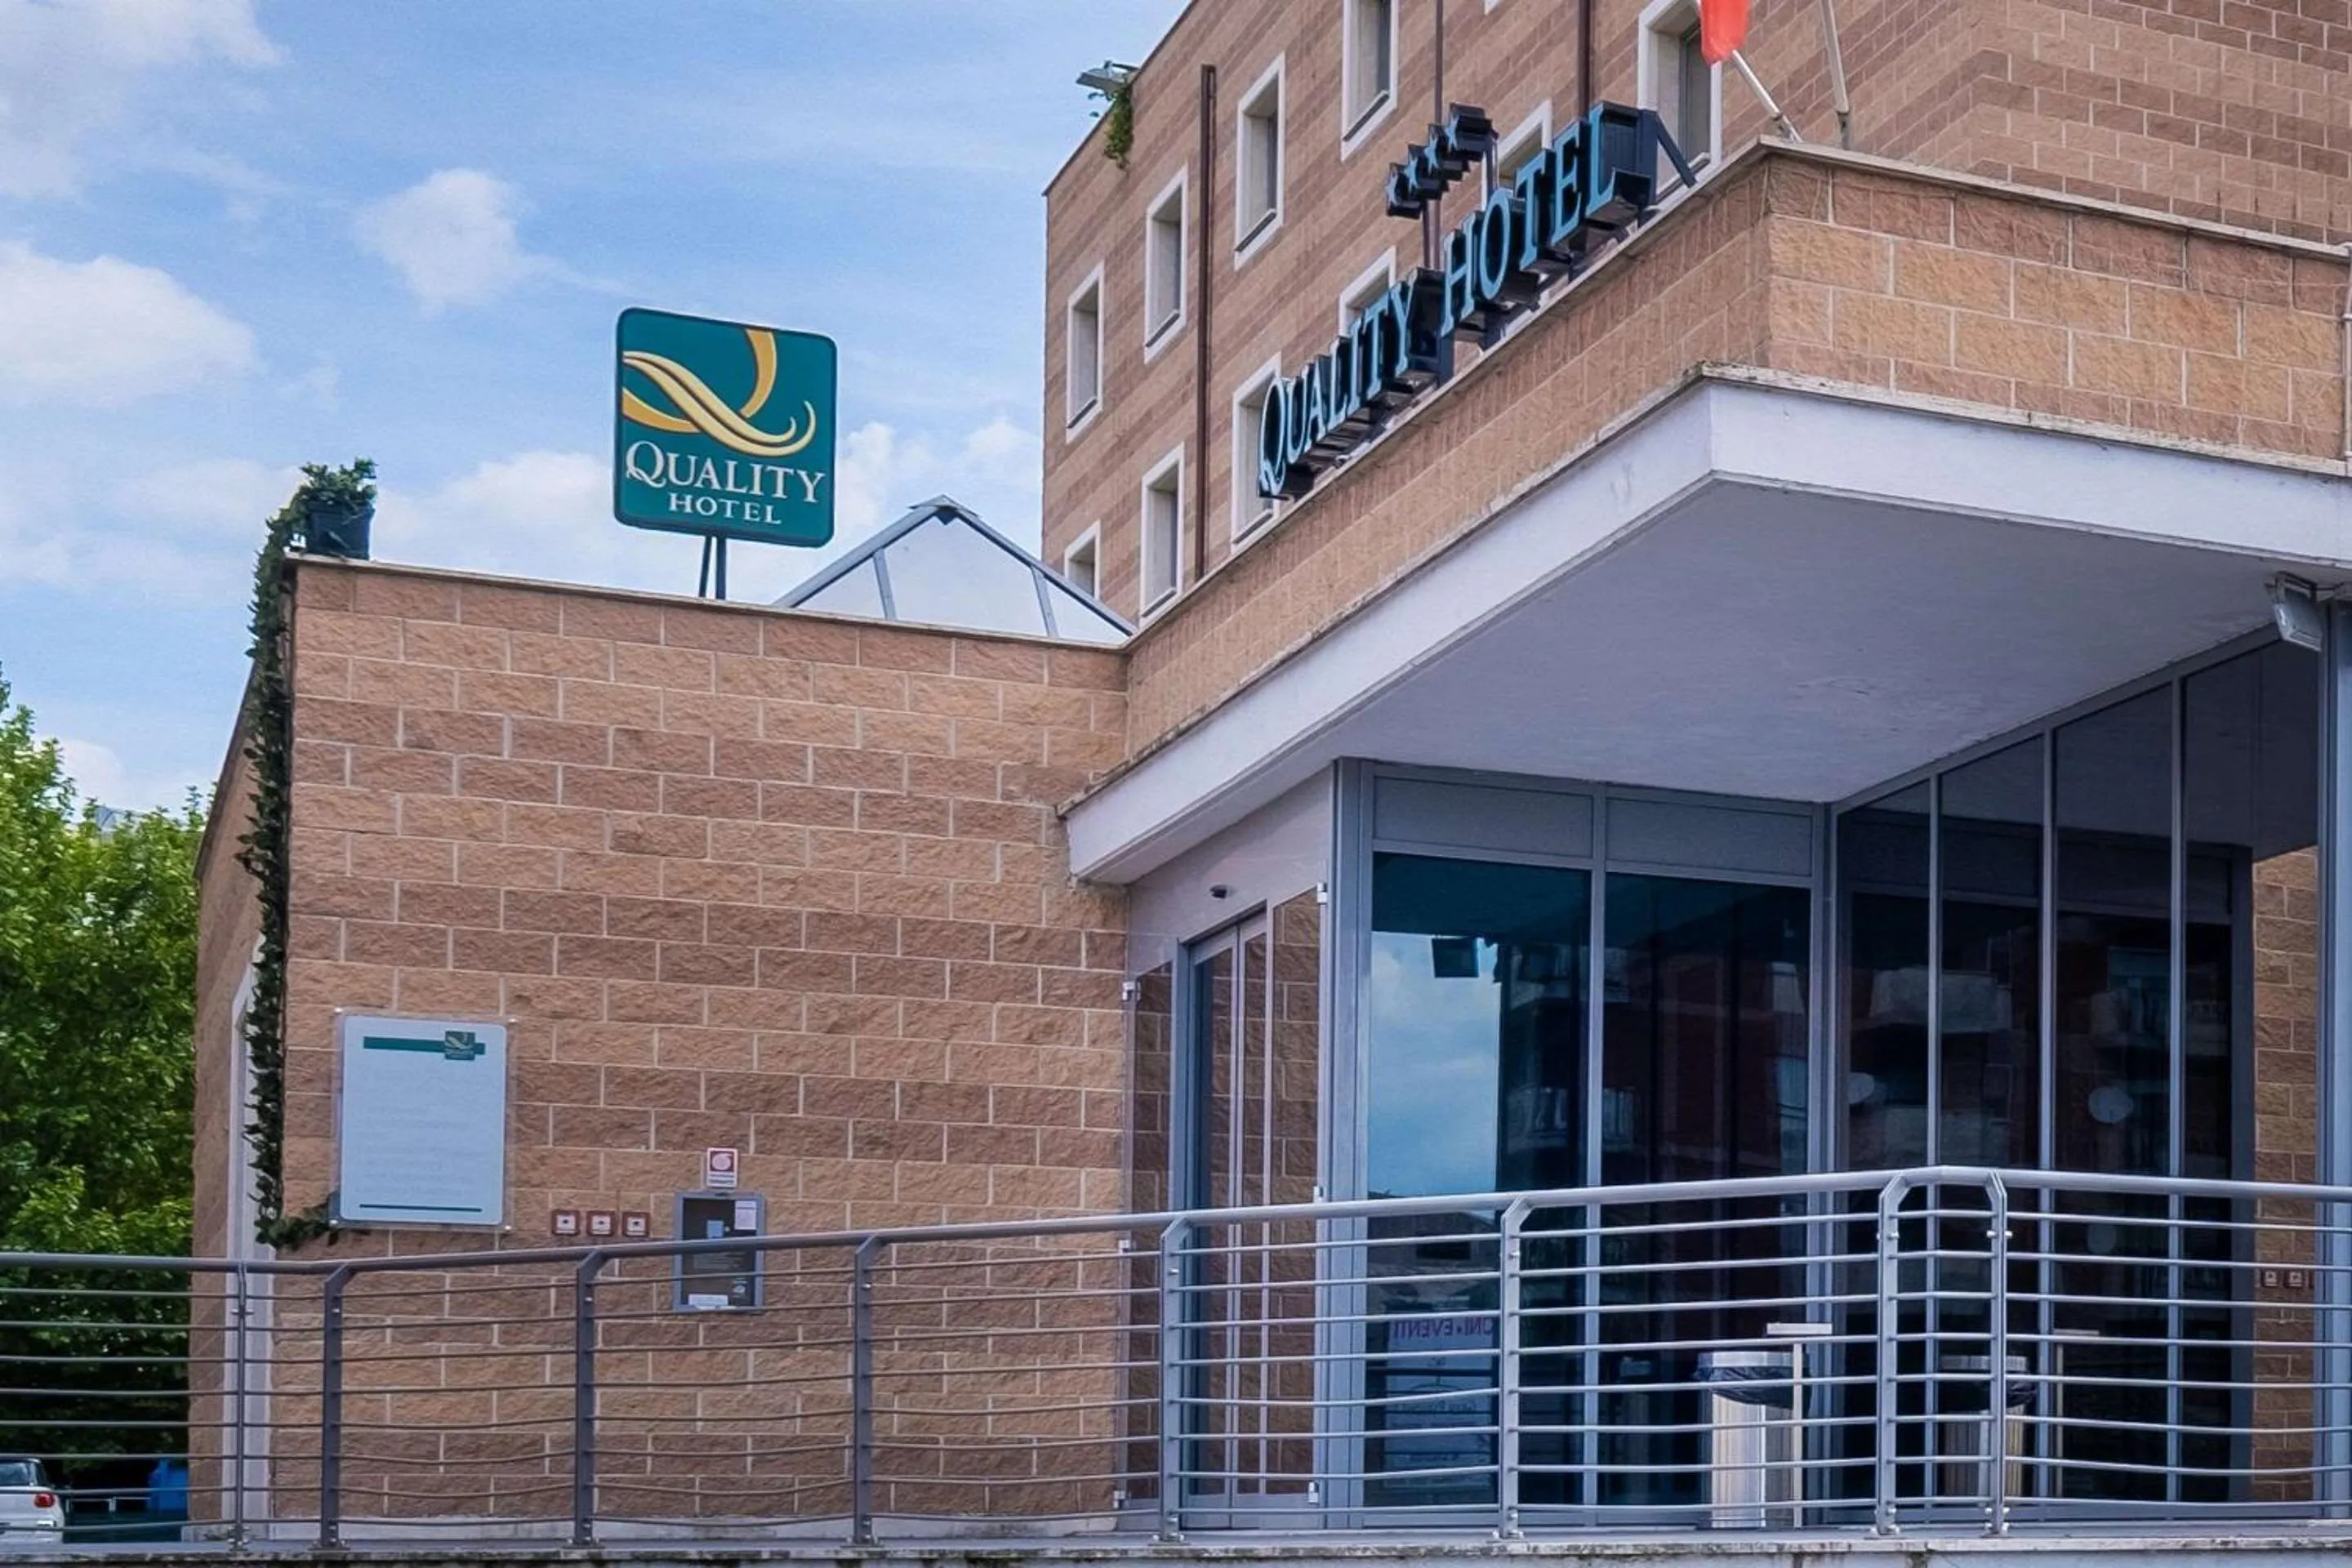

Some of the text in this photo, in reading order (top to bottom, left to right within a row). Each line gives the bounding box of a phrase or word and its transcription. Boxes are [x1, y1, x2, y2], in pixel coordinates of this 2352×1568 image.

[1258, 101, 1617, 495] QUALITY HOTEL
[625, 439, 826, 503] QUALITY
[668, 492, 782, 524] HOTEL
